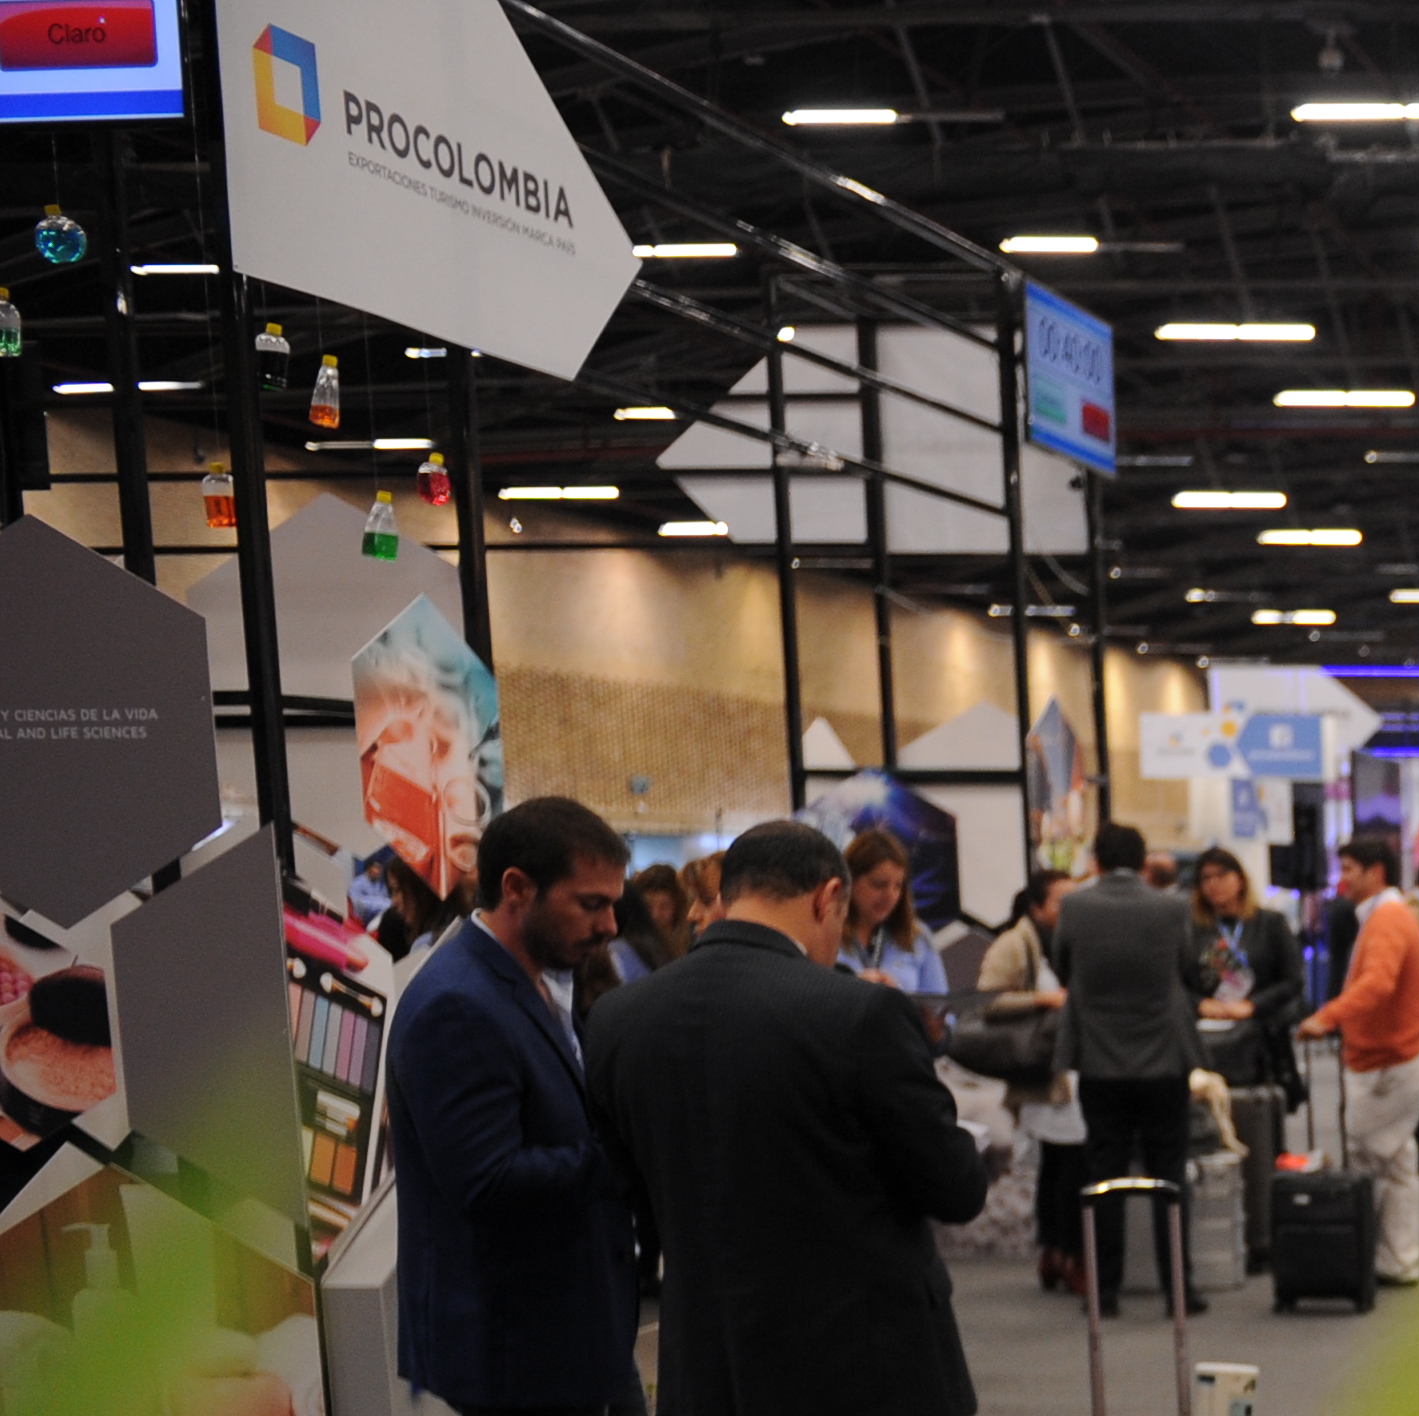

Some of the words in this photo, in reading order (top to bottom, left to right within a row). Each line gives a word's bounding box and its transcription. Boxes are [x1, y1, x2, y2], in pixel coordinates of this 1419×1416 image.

[48, 23, 106, 44] Claro
[343, 89, 573, 228] PROCOLOMBIA
[348, 151, 428, 198] EXPORTACIONES
[429, 185, 470, 216] TURISMO
[14, 709, 76, 722] CIENCIAS
[80, 708, 98, 721] DE
[102, 708, 121, 721] LA
[124, 708, 159, 721] VIDA
[17, 727, 46, 740] AND
[51, 727, 78, 739] LIFE
[83, 726, 147, 739] SCIENCES
